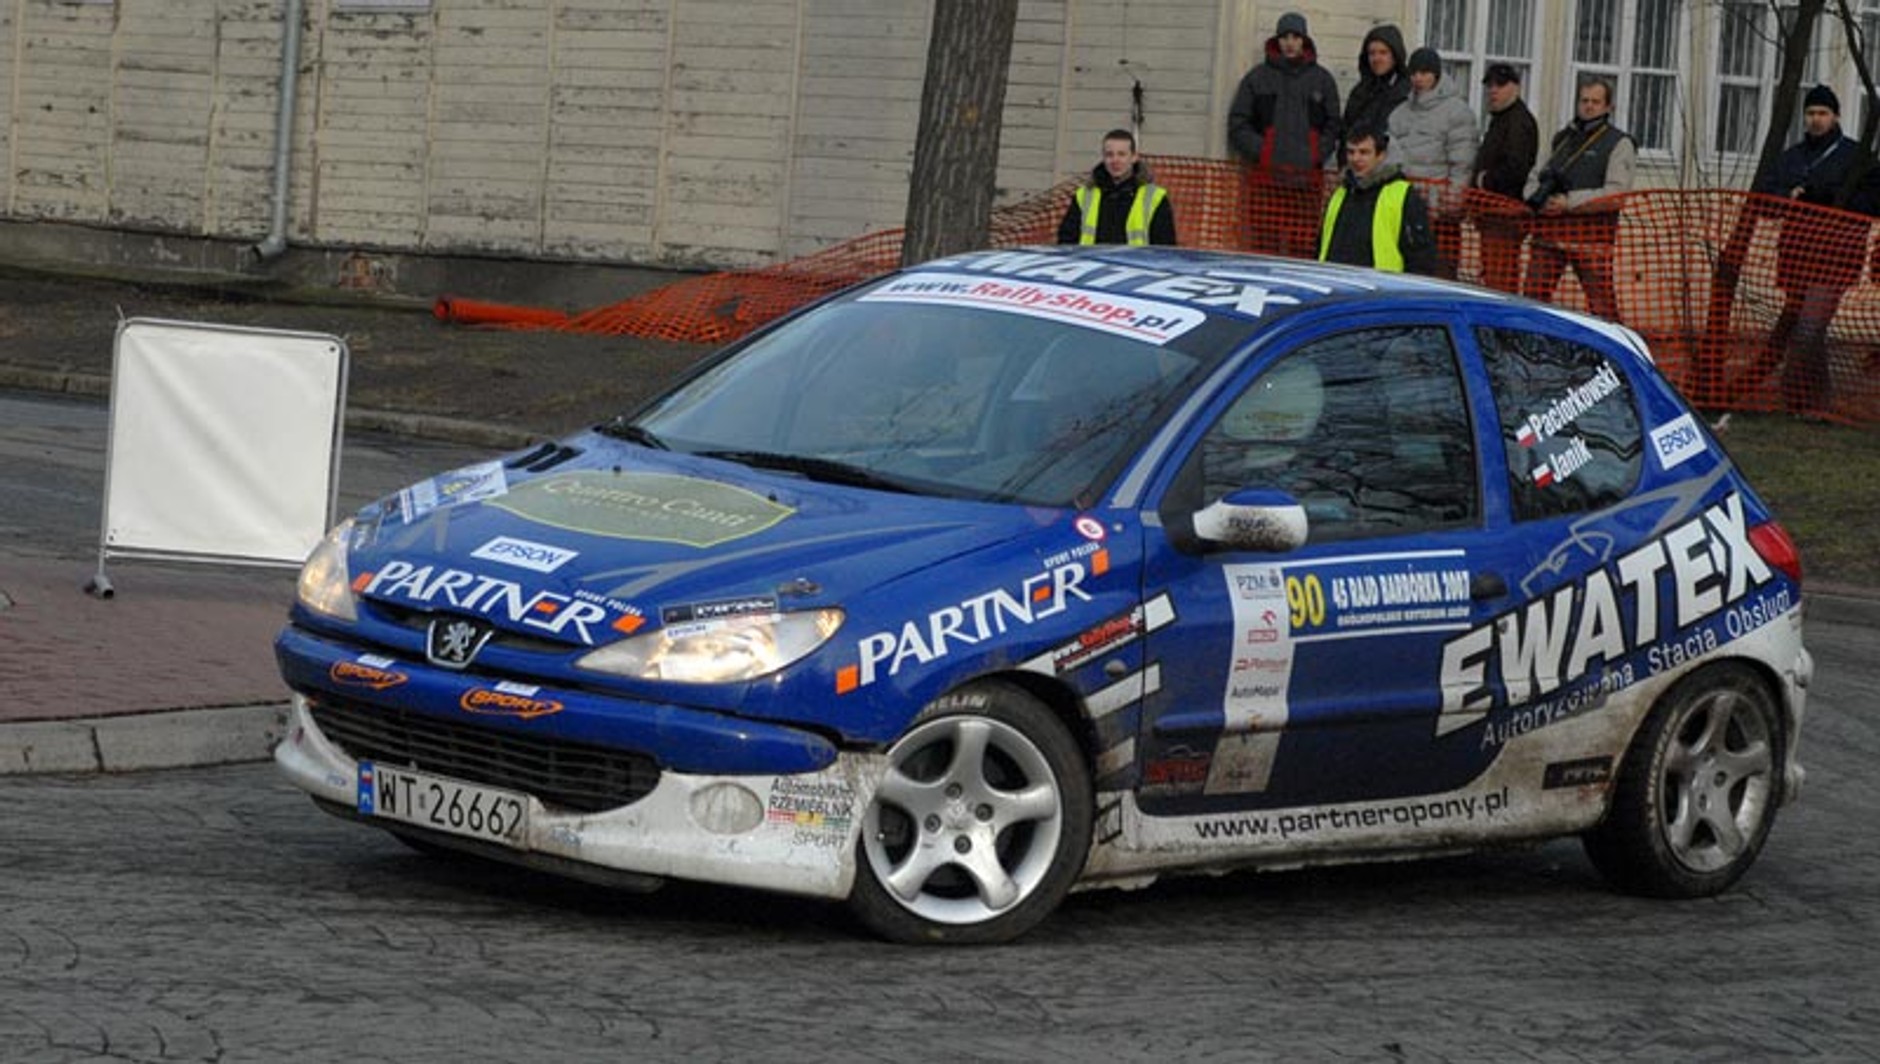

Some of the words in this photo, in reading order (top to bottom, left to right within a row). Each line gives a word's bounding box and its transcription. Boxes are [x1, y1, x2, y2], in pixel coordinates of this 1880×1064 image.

[890, 281, 1184, 332] www.RallyShop.pl
[1528, 360, 1621, 443] Paciorkowski
[1550, 435, 1593, 484] Janik
[1658, 424, 1697, 456] EPSON
[488, 541, 561, 565] EPSON
[364, 560, 606, 644] PARTNER
[858, 561, 1092, 687] PARTNER
[1285, 572, 1325, 629] 90
[1436, 491, 1772, 738] EWATEX
[470, 689, 553, 713] SPORT
[377, 770, 418, 818] WT
[429, 783, 523, 841] 26662
[1194, 787, 1509, 838] www.partneropony.pl
